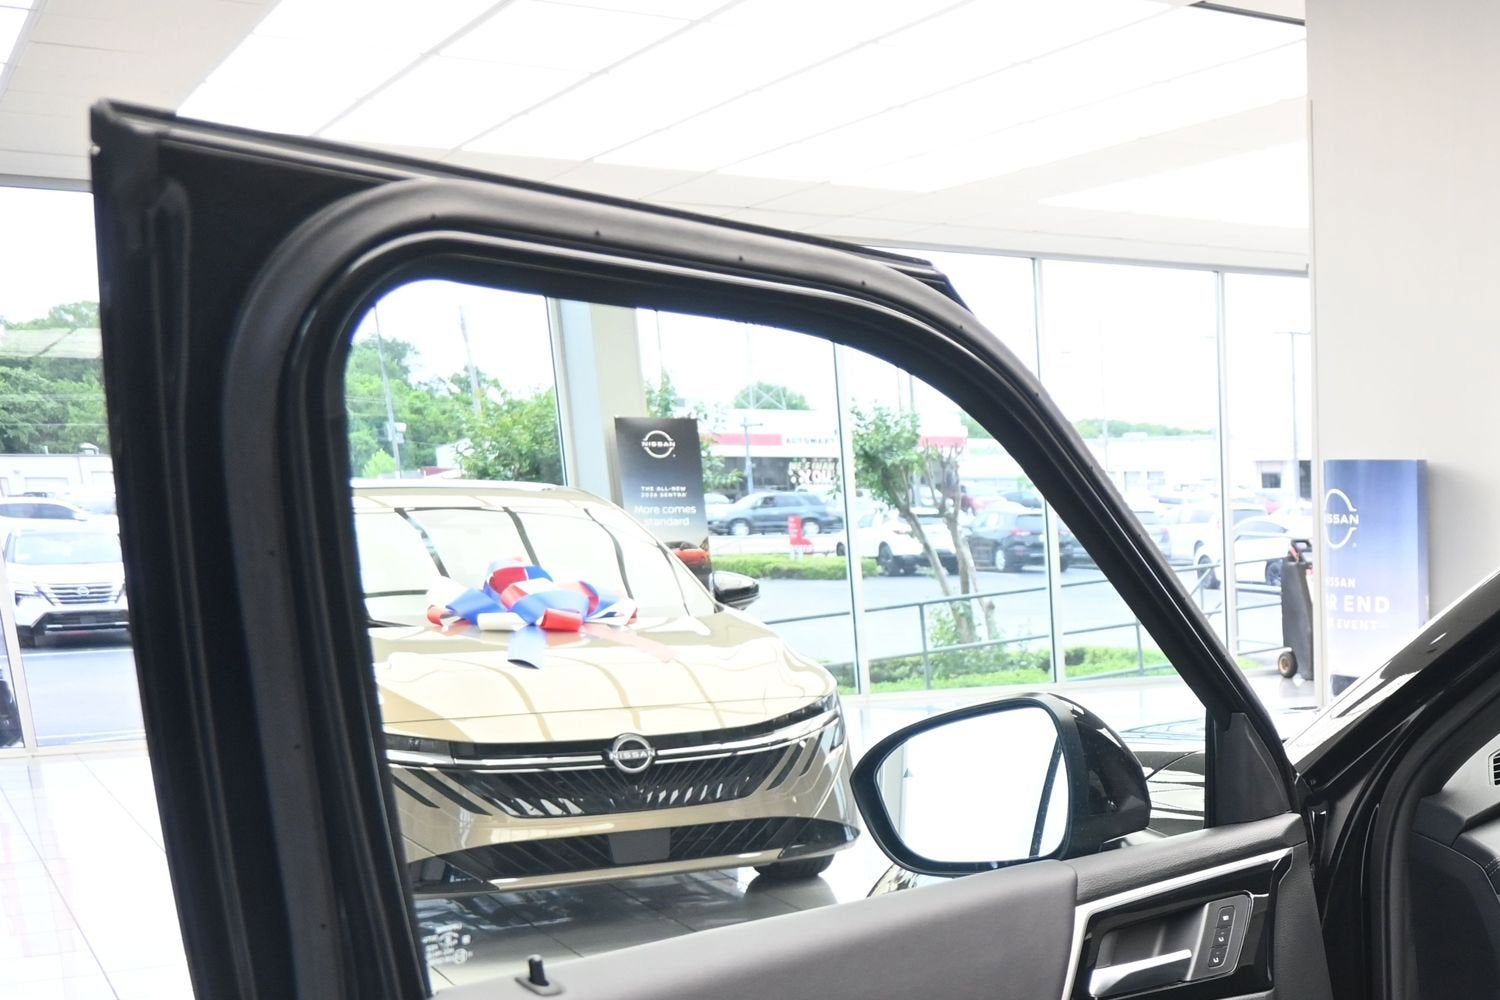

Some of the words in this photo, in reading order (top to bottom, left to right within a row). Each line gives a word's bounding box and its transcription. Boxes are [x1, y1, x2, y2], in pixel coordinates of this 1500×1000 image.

[641, 440, 675, 448] NISSAN
[634, 505, 660, 514] More
[662, 506, 697, 514] comes
[1326, 514, 1359, 525] SSAN
[1343, 594, 1390, 613] END
[1336, 618, 1377, 630] EVENT
[609, 749, 655, 760] NISSAN
